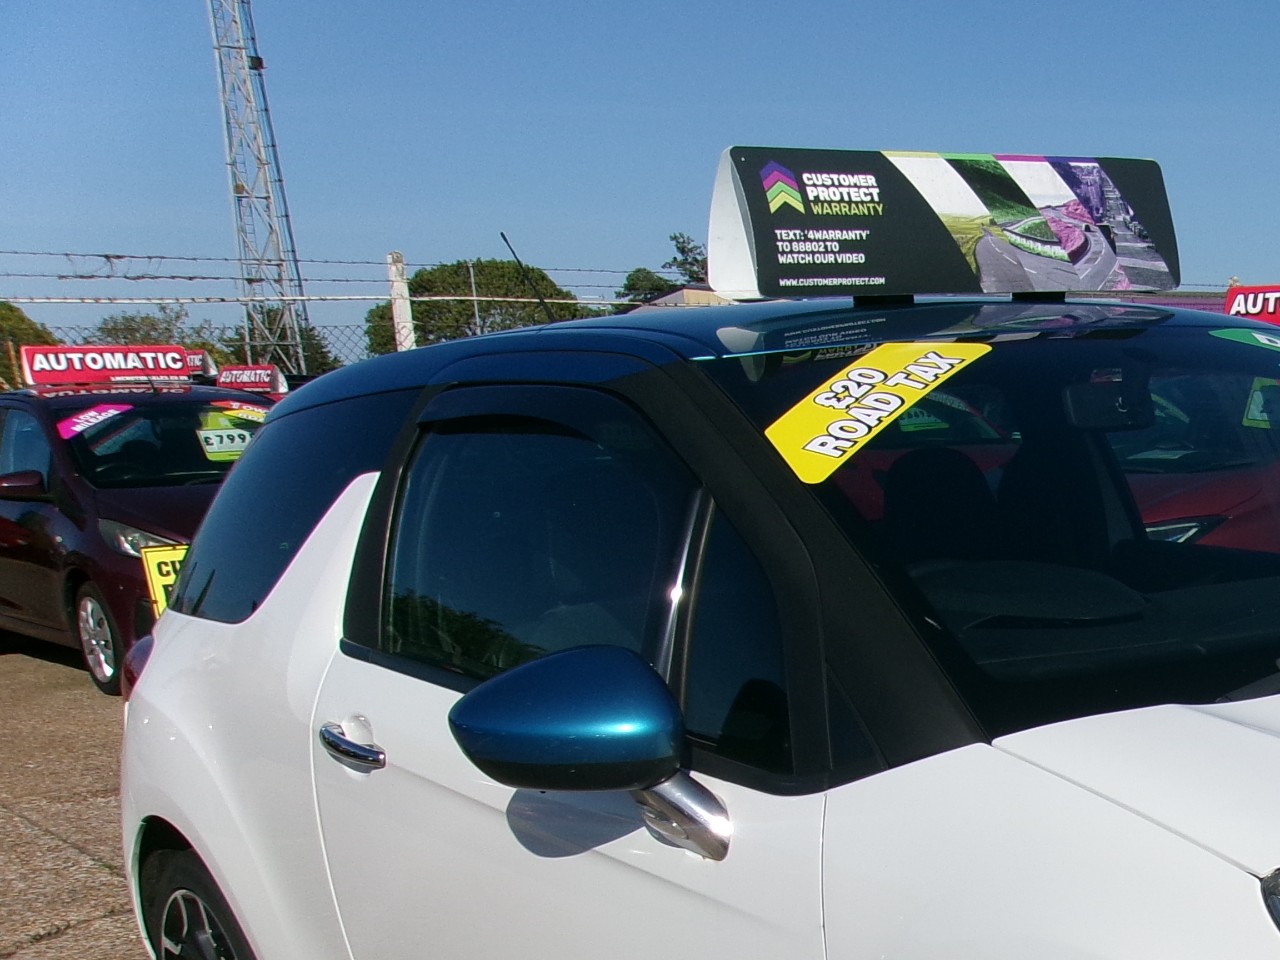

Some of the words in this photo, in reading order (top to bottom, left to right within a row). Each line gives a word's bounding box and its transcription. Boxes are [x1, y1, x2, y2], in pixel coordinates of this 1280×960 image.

[802, 173, 878, 186] CUSTOMER
[806, 186, 880, 201] PROTECT
[810, 202, 884, 216] WARRANTY
[775, 229, 804, 240] TEXT:
[776, 242, 790, 252] TO
[792, 242, 825, 252] 88802
[826, 242, 839, 252] TO
[778, 253, 813, 264] WATCH
[814, 253, 837, 264] OUR
[837, 253, 865, 263] VIDEO
[779, 277, 885, 287] WWW.CUSTOMERPROTECT.COM
[32, 351, 184, 373] AUTOMATIC
[219, 369, 272, 383] AUTOMATIC
[812, 367, 888, 410] £20
[801, 391, 906, 458] ROAD
[884, 351, 967, 390] TAX
[72, 410, 99, 423] LOW
